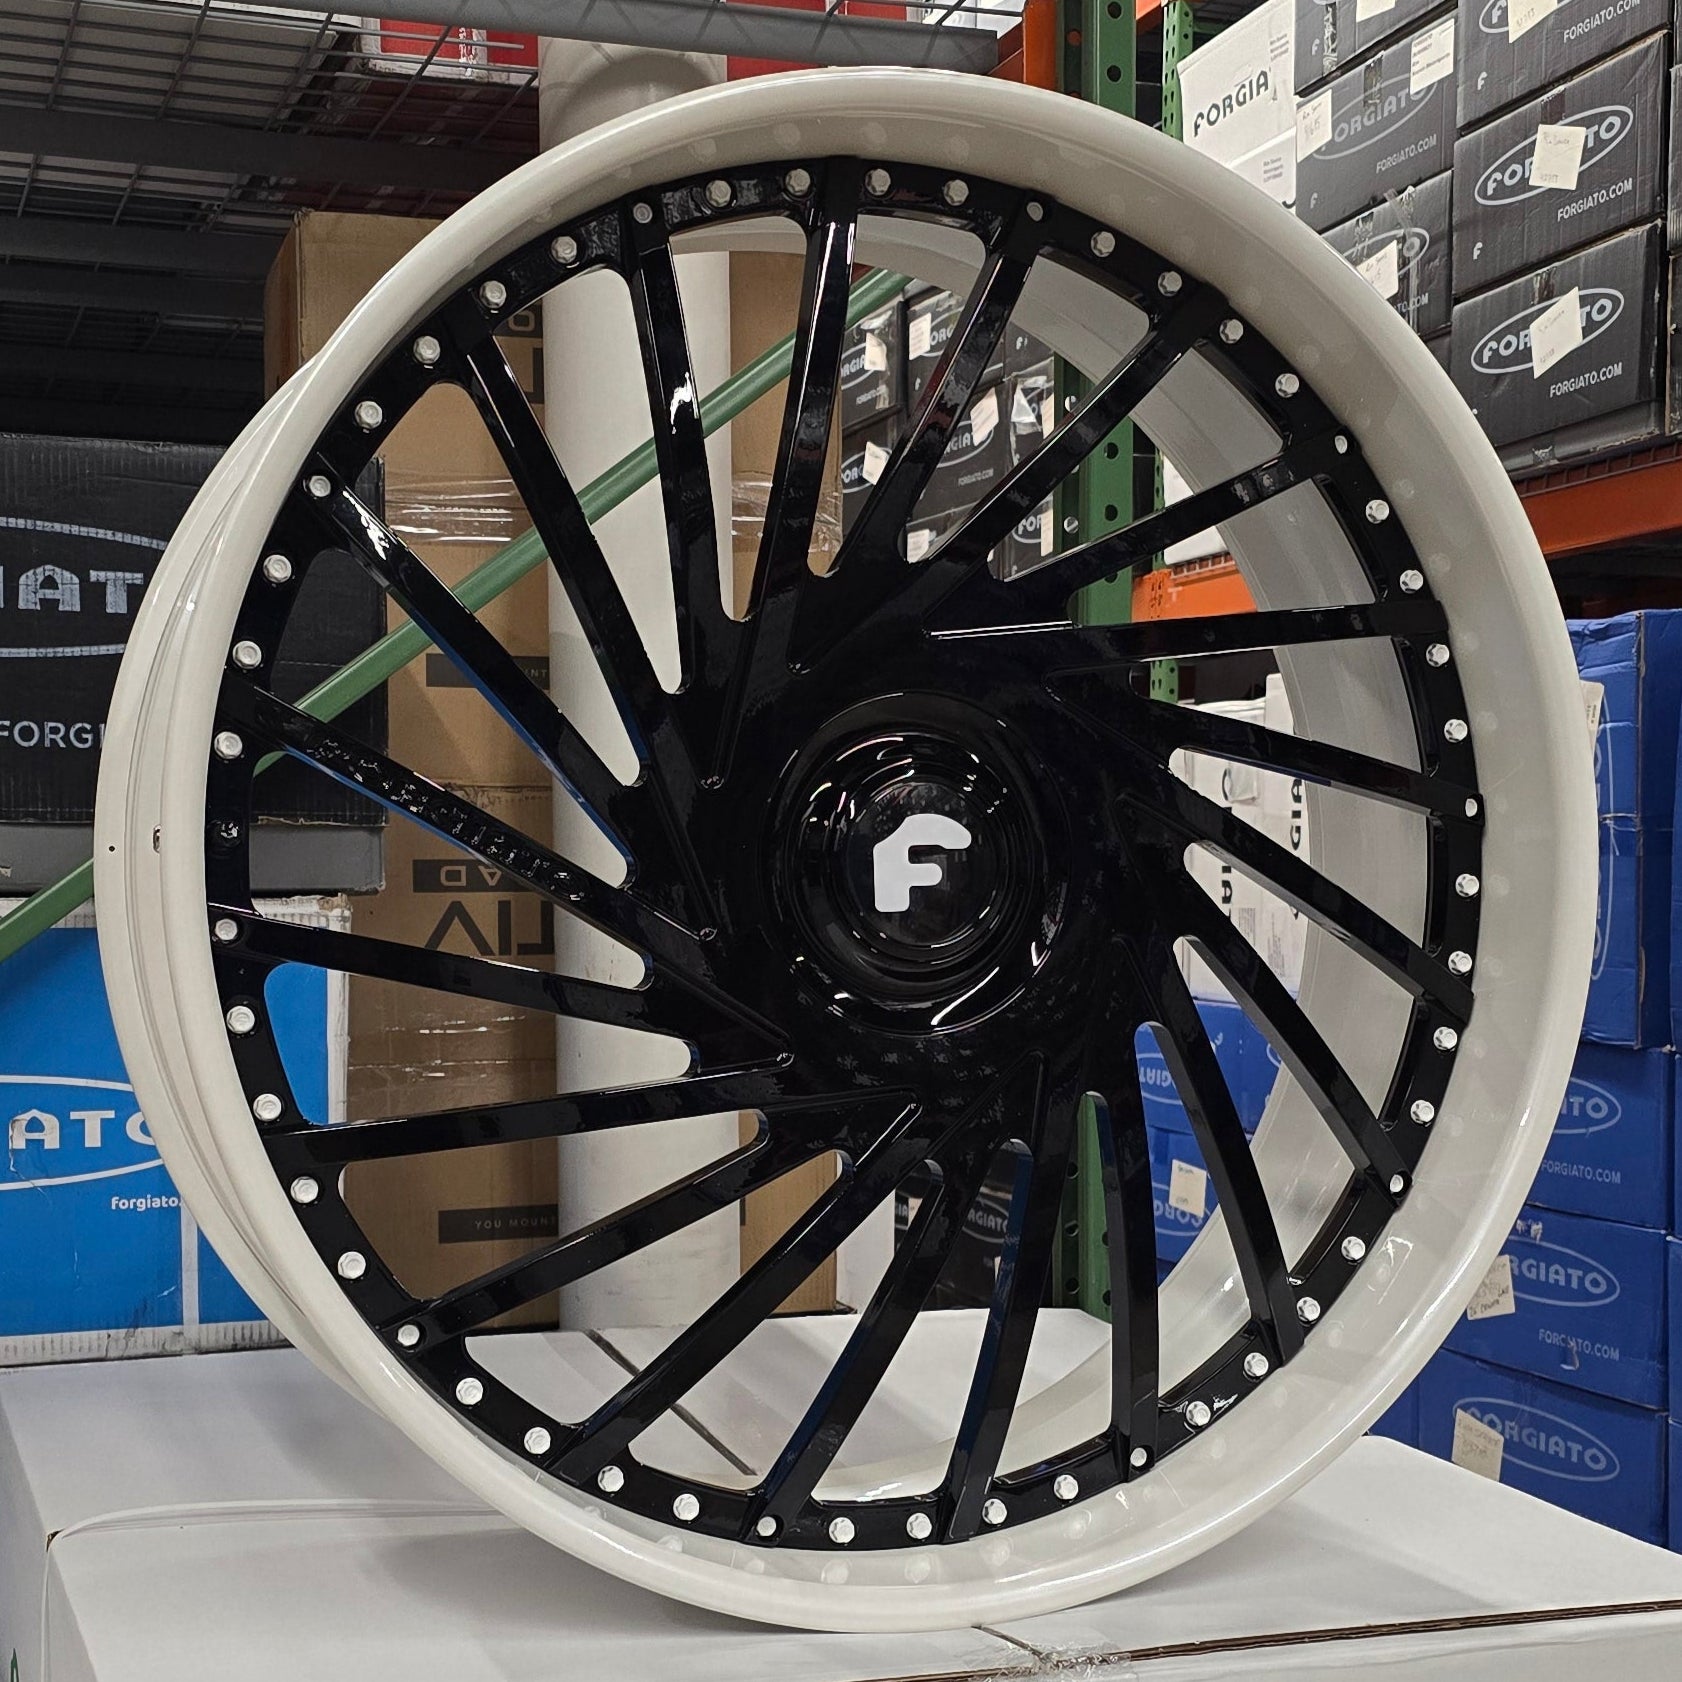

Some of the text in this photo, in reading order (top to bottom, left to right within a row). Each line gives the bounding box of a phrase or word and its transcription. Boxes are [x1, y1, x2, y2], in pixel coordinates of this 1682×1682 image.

[1563, 0, 1640, 43] FORGIATO.COM
[1193, 67, 1271, 138] FORGIA
[1321, 84, 1427, 151] ORGIAT
[1376, 134, 1437, 174] FORGIATO.COM
[1487, 115, 1621, 196] FOTO
[1557, 177, 1633, 222] FORGIATO.COM
[1482, 298, 1613, 364] FORTO
[1549, 362, 1623, 398] FORGIATO.COM
[0, 720, 105, 749] ORGI
[1509, 1255, 1607, 1294] RGIATO
